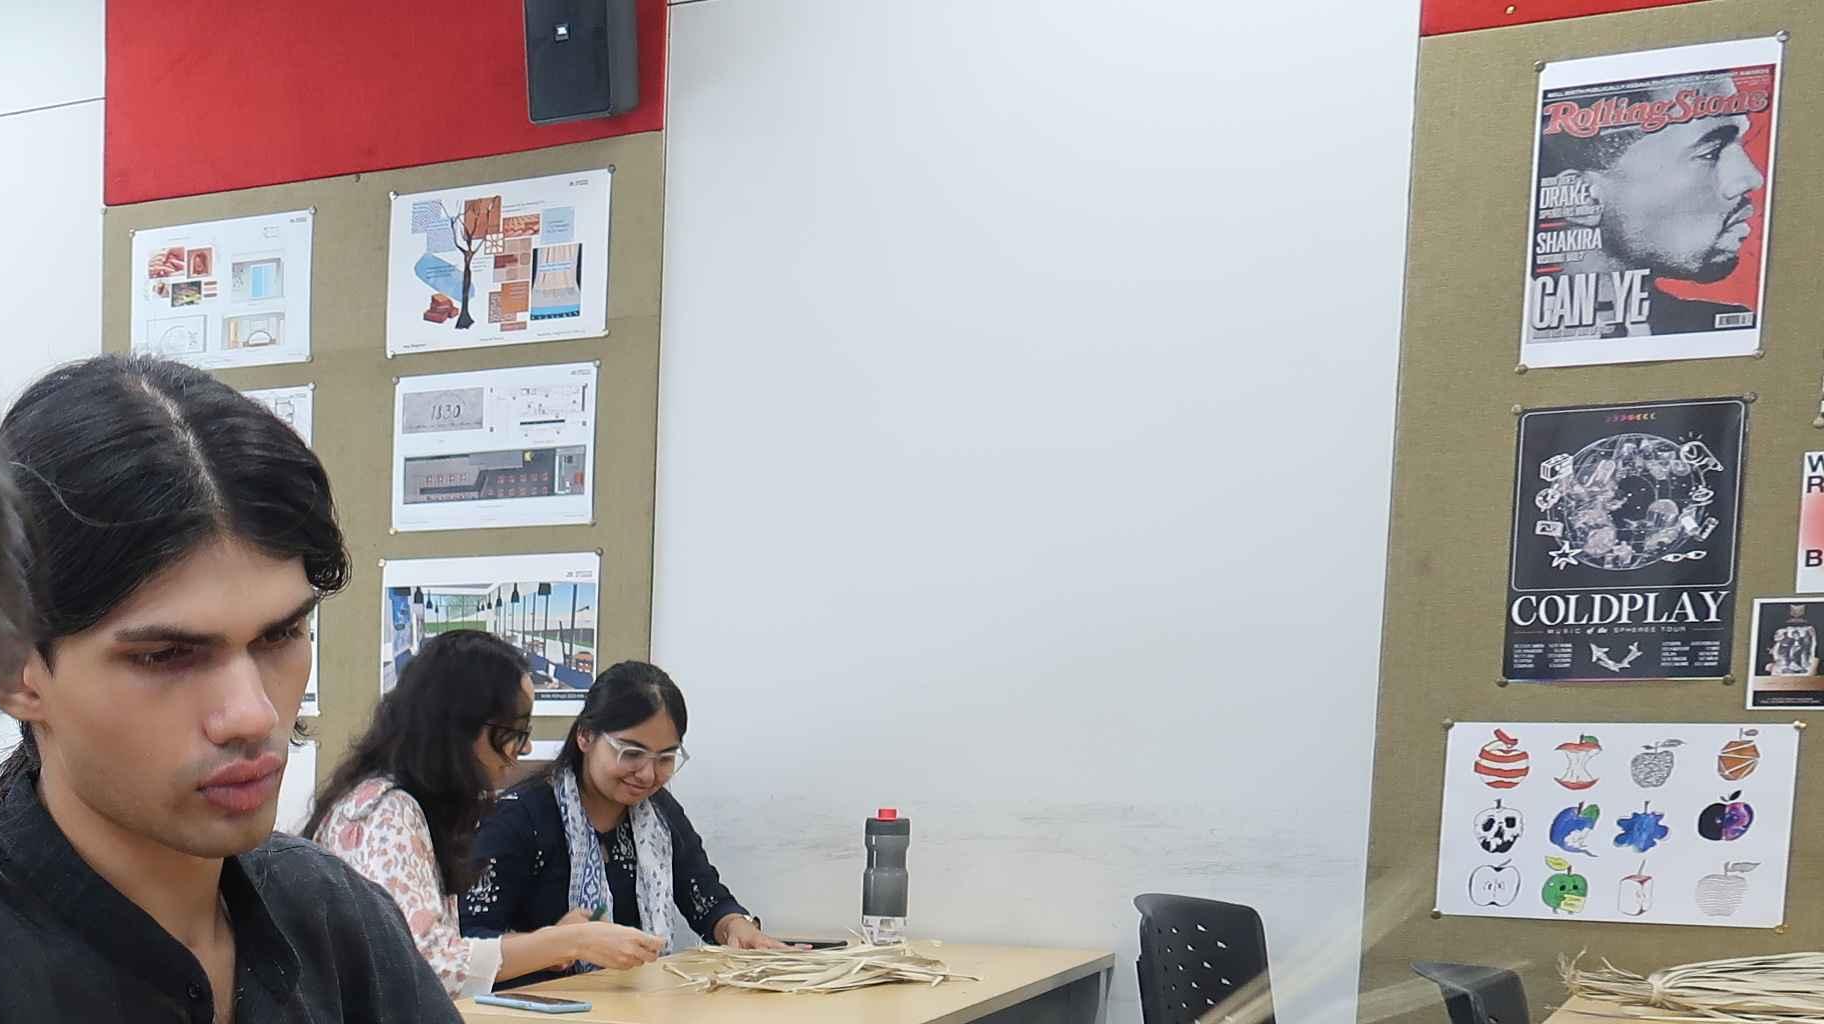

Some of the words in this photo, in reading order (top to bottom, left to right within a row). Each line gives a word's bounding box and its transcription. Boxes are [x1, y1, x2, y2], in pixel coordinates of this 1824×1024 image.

[1539, 180, 1591, 208] DRAKE
[1536, 227, 1603, 254] SHAKIRA
[1511, 590, 1730, 626] COLDPLAY
